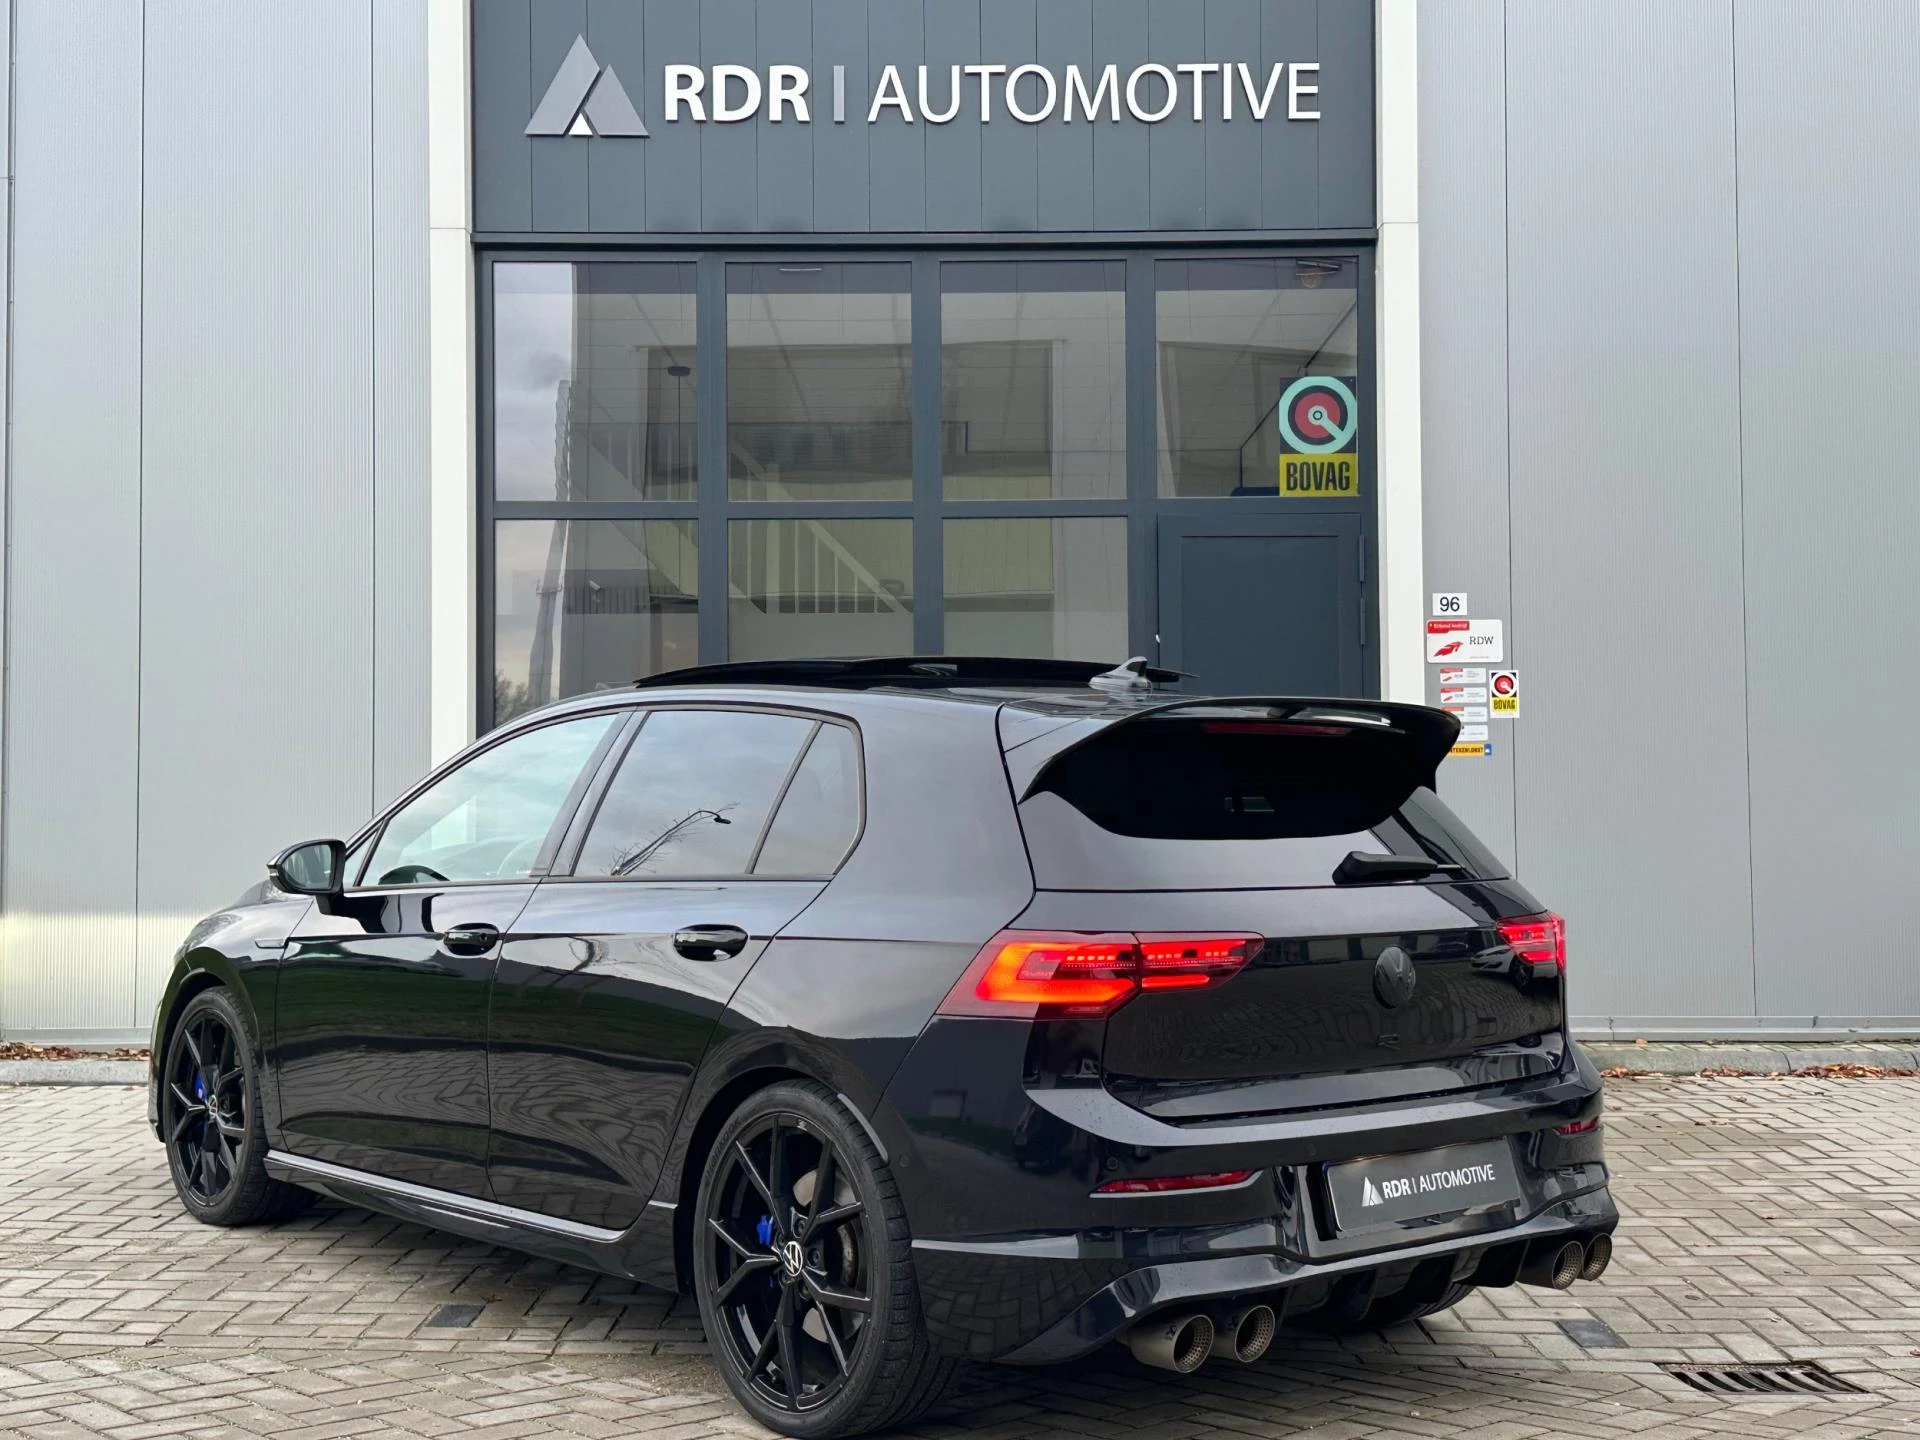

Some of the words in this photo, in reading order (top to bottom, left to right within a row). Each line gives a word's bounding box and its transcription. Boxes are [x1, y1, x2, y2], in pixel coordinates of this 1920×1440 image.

[663, 64, 810, 123] RDR
[867, 61, 1322, 124] AUTOMOTIVE
[1286, 461, 1351, 491] BOVAG
[1439, 596, 1460, 612] 96
[1469, 636, 1494, 645] RDW
[1493, 699, 1516, 710] BOVAG
[1382, 1178, 1411, 1199] RDR
[1419, 1163, 1496, 1193] AUTOMOTIVE
